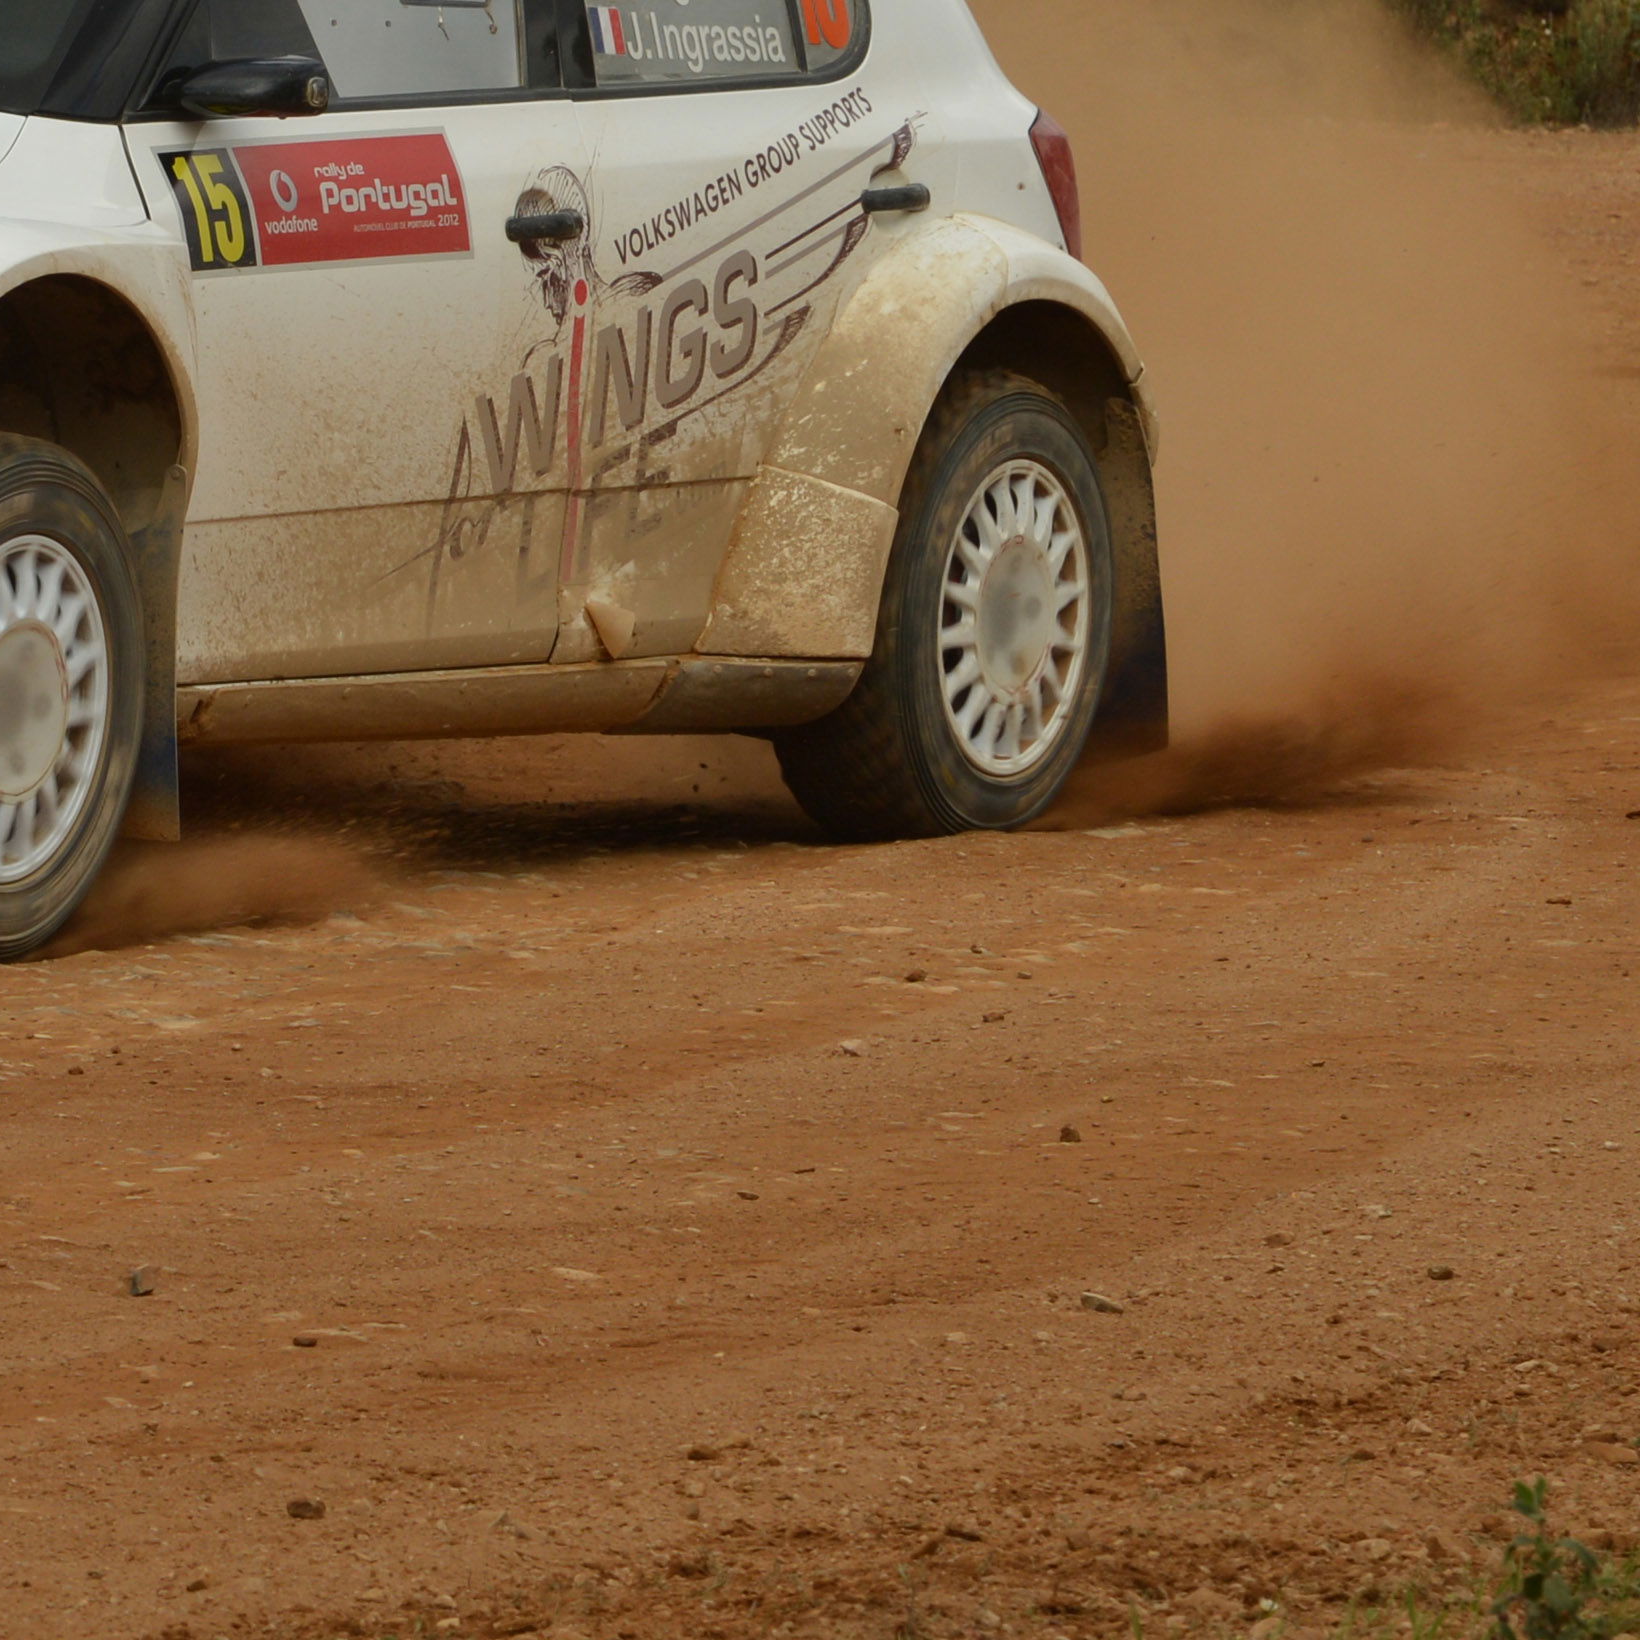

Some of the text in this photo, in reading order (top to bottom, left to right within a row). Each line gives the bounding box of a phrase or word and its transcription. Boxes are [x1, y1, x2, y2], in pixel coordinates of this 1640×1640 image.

[313, 161, 364, 179] rally de
[614, 86, 874, 266] VOLKSWAGEN GROUP SUPPORTS
[172, 153, 246, 264] 15
[319, 173, 459, 217] Portugal
[264, 214, 319, 236] vodafone
[437, 213, 460, 227] 2012
